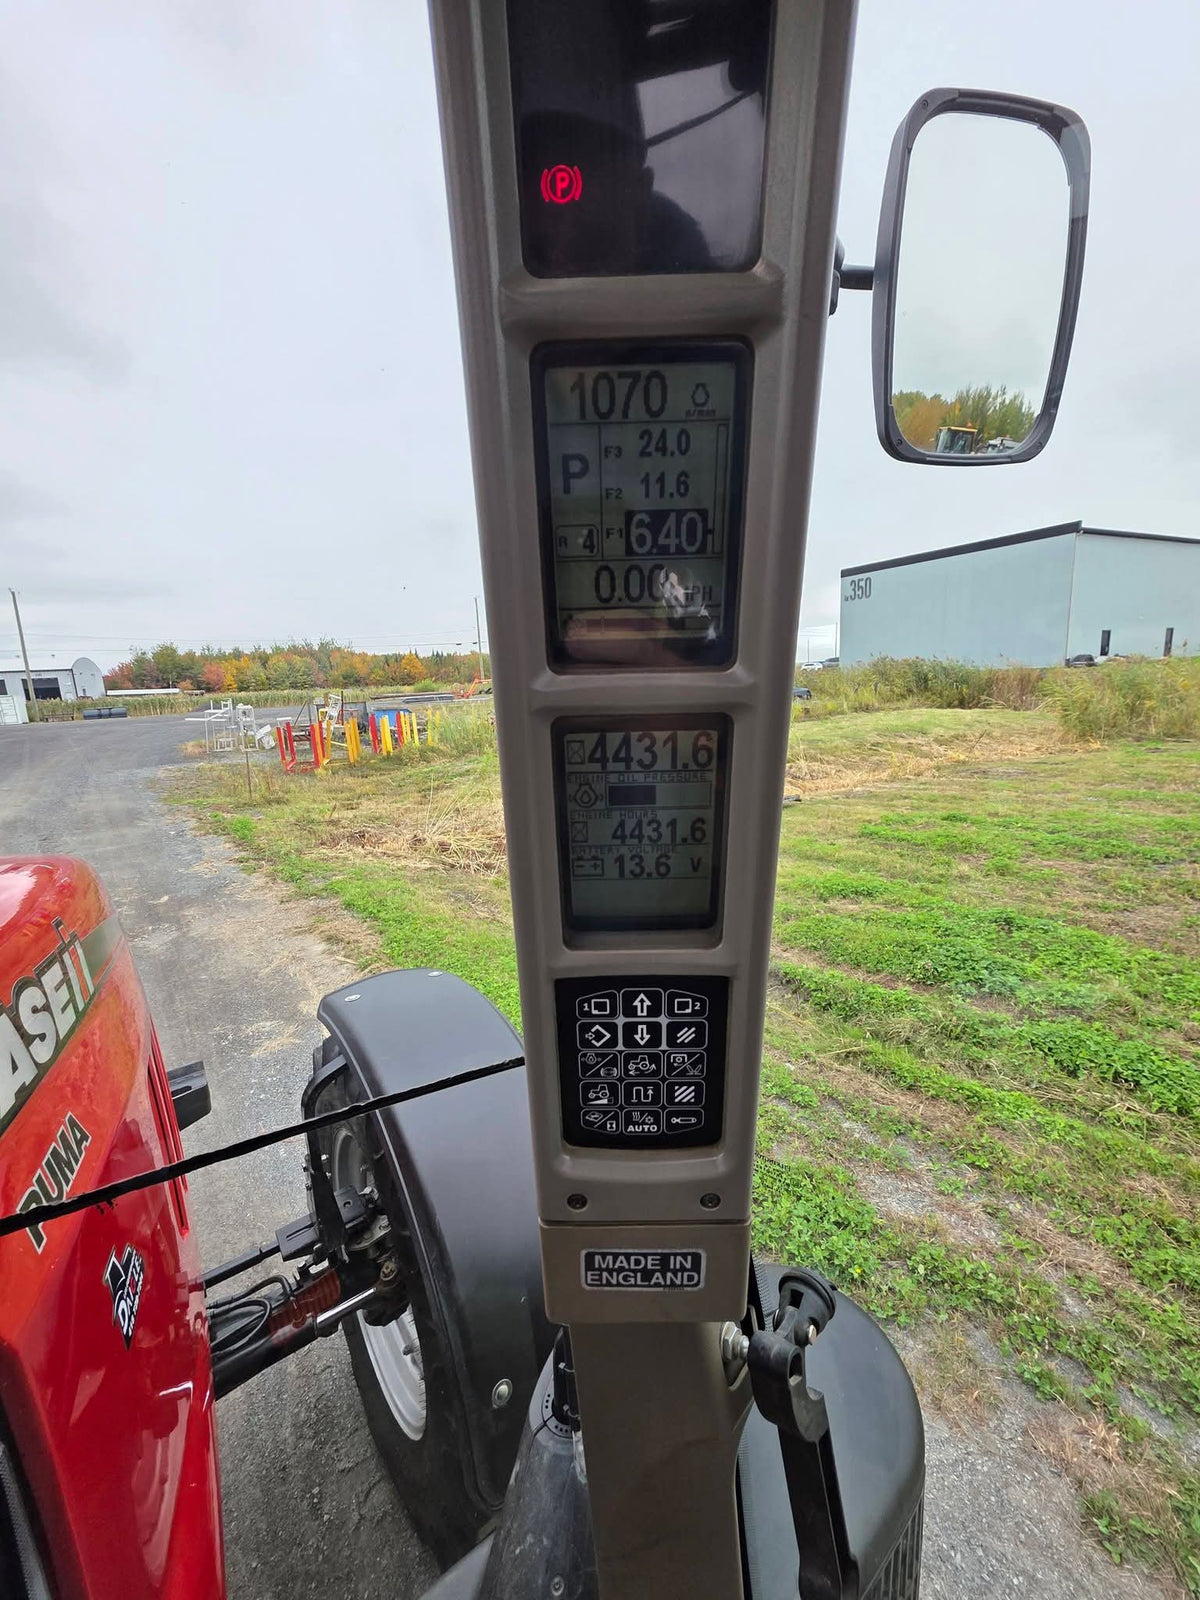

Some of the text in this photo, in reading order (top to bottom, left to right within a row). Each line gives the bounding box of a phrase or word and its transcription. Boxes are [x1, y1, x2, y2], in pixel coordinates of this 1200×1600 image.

[570, 370, 668, 421] 1070
[604, 429, 691, 458] F3 24.0
[562, 453, 589, 495] P
[605, 471, 690, 500] F2 11.6
[583, 529, 595, 554] 4
[606, 511, 702, 555] F1 6.40
[850, 577, 872, 601] 350
[587, 731, 714, 770] 4431.6
[567, 772, 707, 784] ENGINE OIL PRESSURE
[570, 809, 658, 820] ENGINE HOURS
[611, 817, 707, 844] 4431.6
[614, 854, 702, 878] 13.6 V
[583, 1003, 590, 1011] 1
[694, 1002, 701, 1010] 2
[0, 958, 77, 1120] ASE
[16, 1111, 92, 1255] PUMA
[594, 1255, 692, 1270] MADE IN
[586, 1271, 699, 1286] ENGLAND
